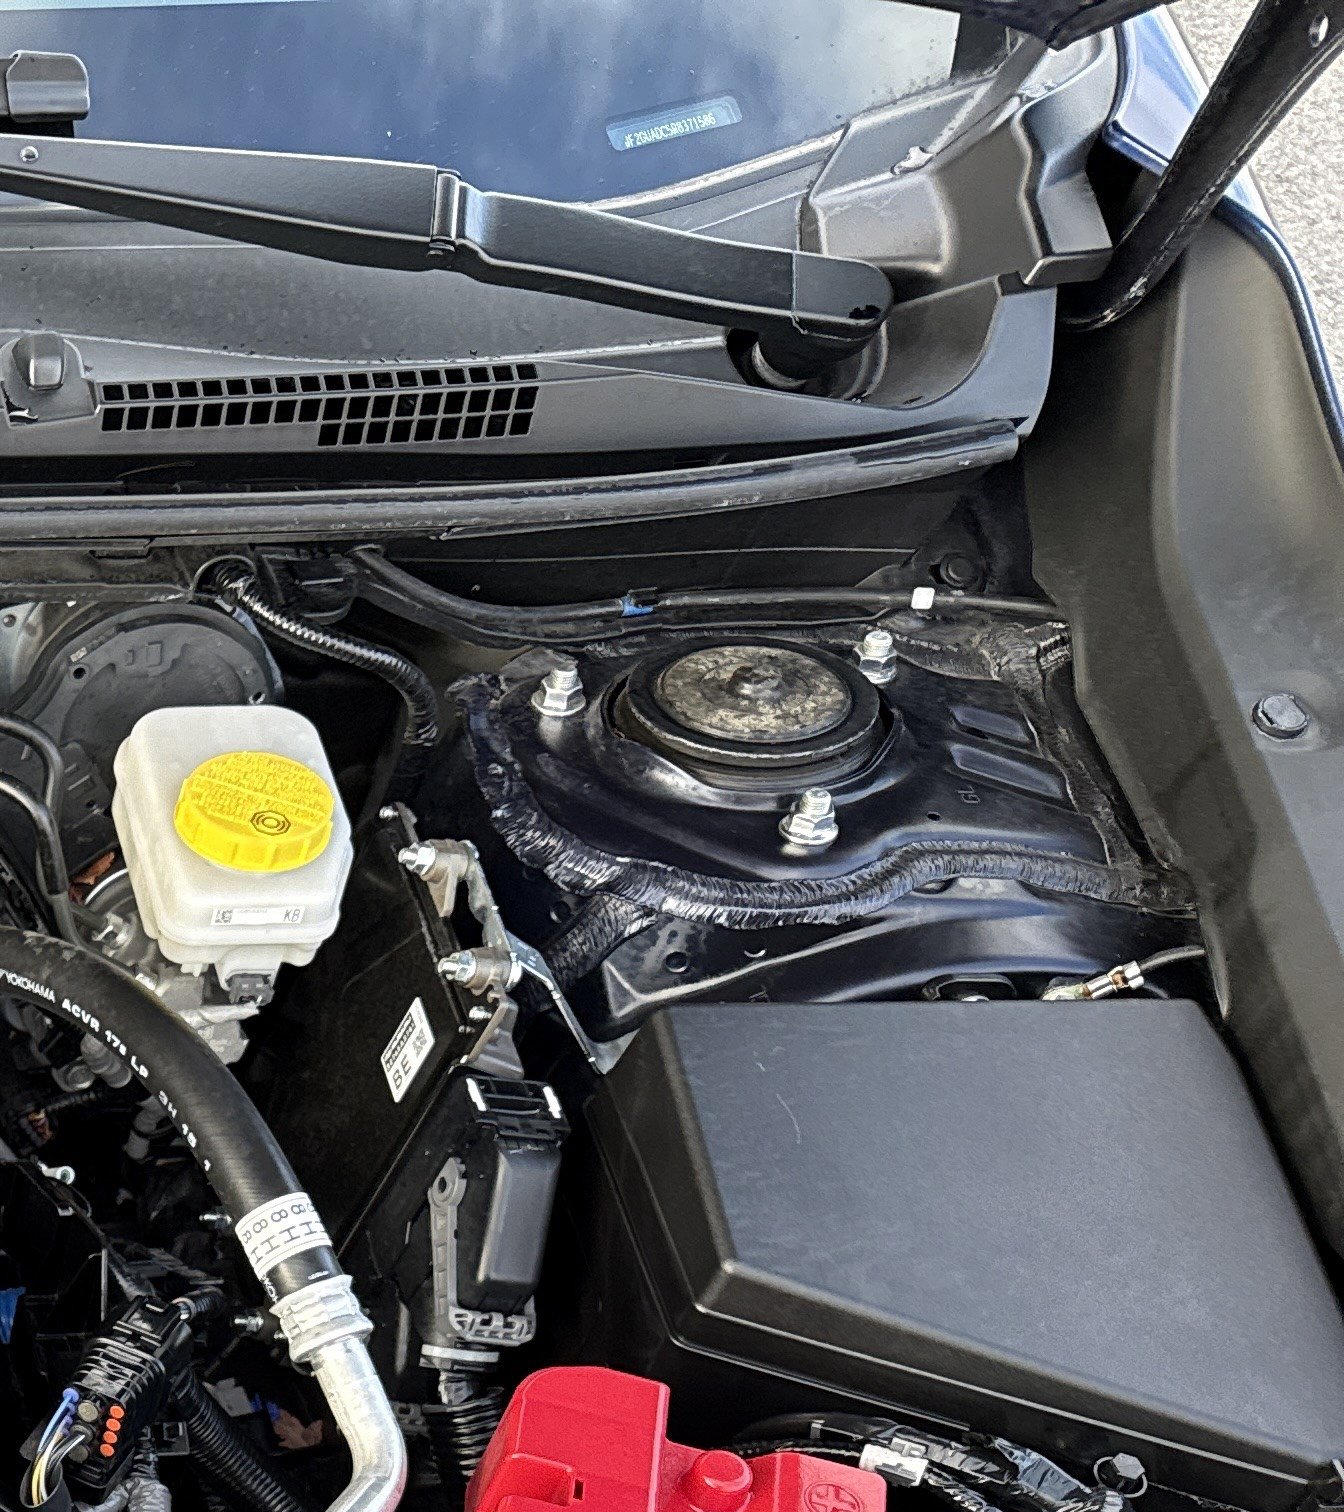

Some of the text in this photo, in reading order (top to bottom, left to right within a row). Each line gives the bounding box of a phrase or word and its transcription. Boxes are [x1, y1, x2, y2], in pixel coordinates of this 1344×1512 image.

[283, 908, 300, 922] KB
[3, 968, 56, 1004] YOKOHAMA
[62, 998, 100, 1032] ACVR
[130, 1055, 149, 1078] LP
